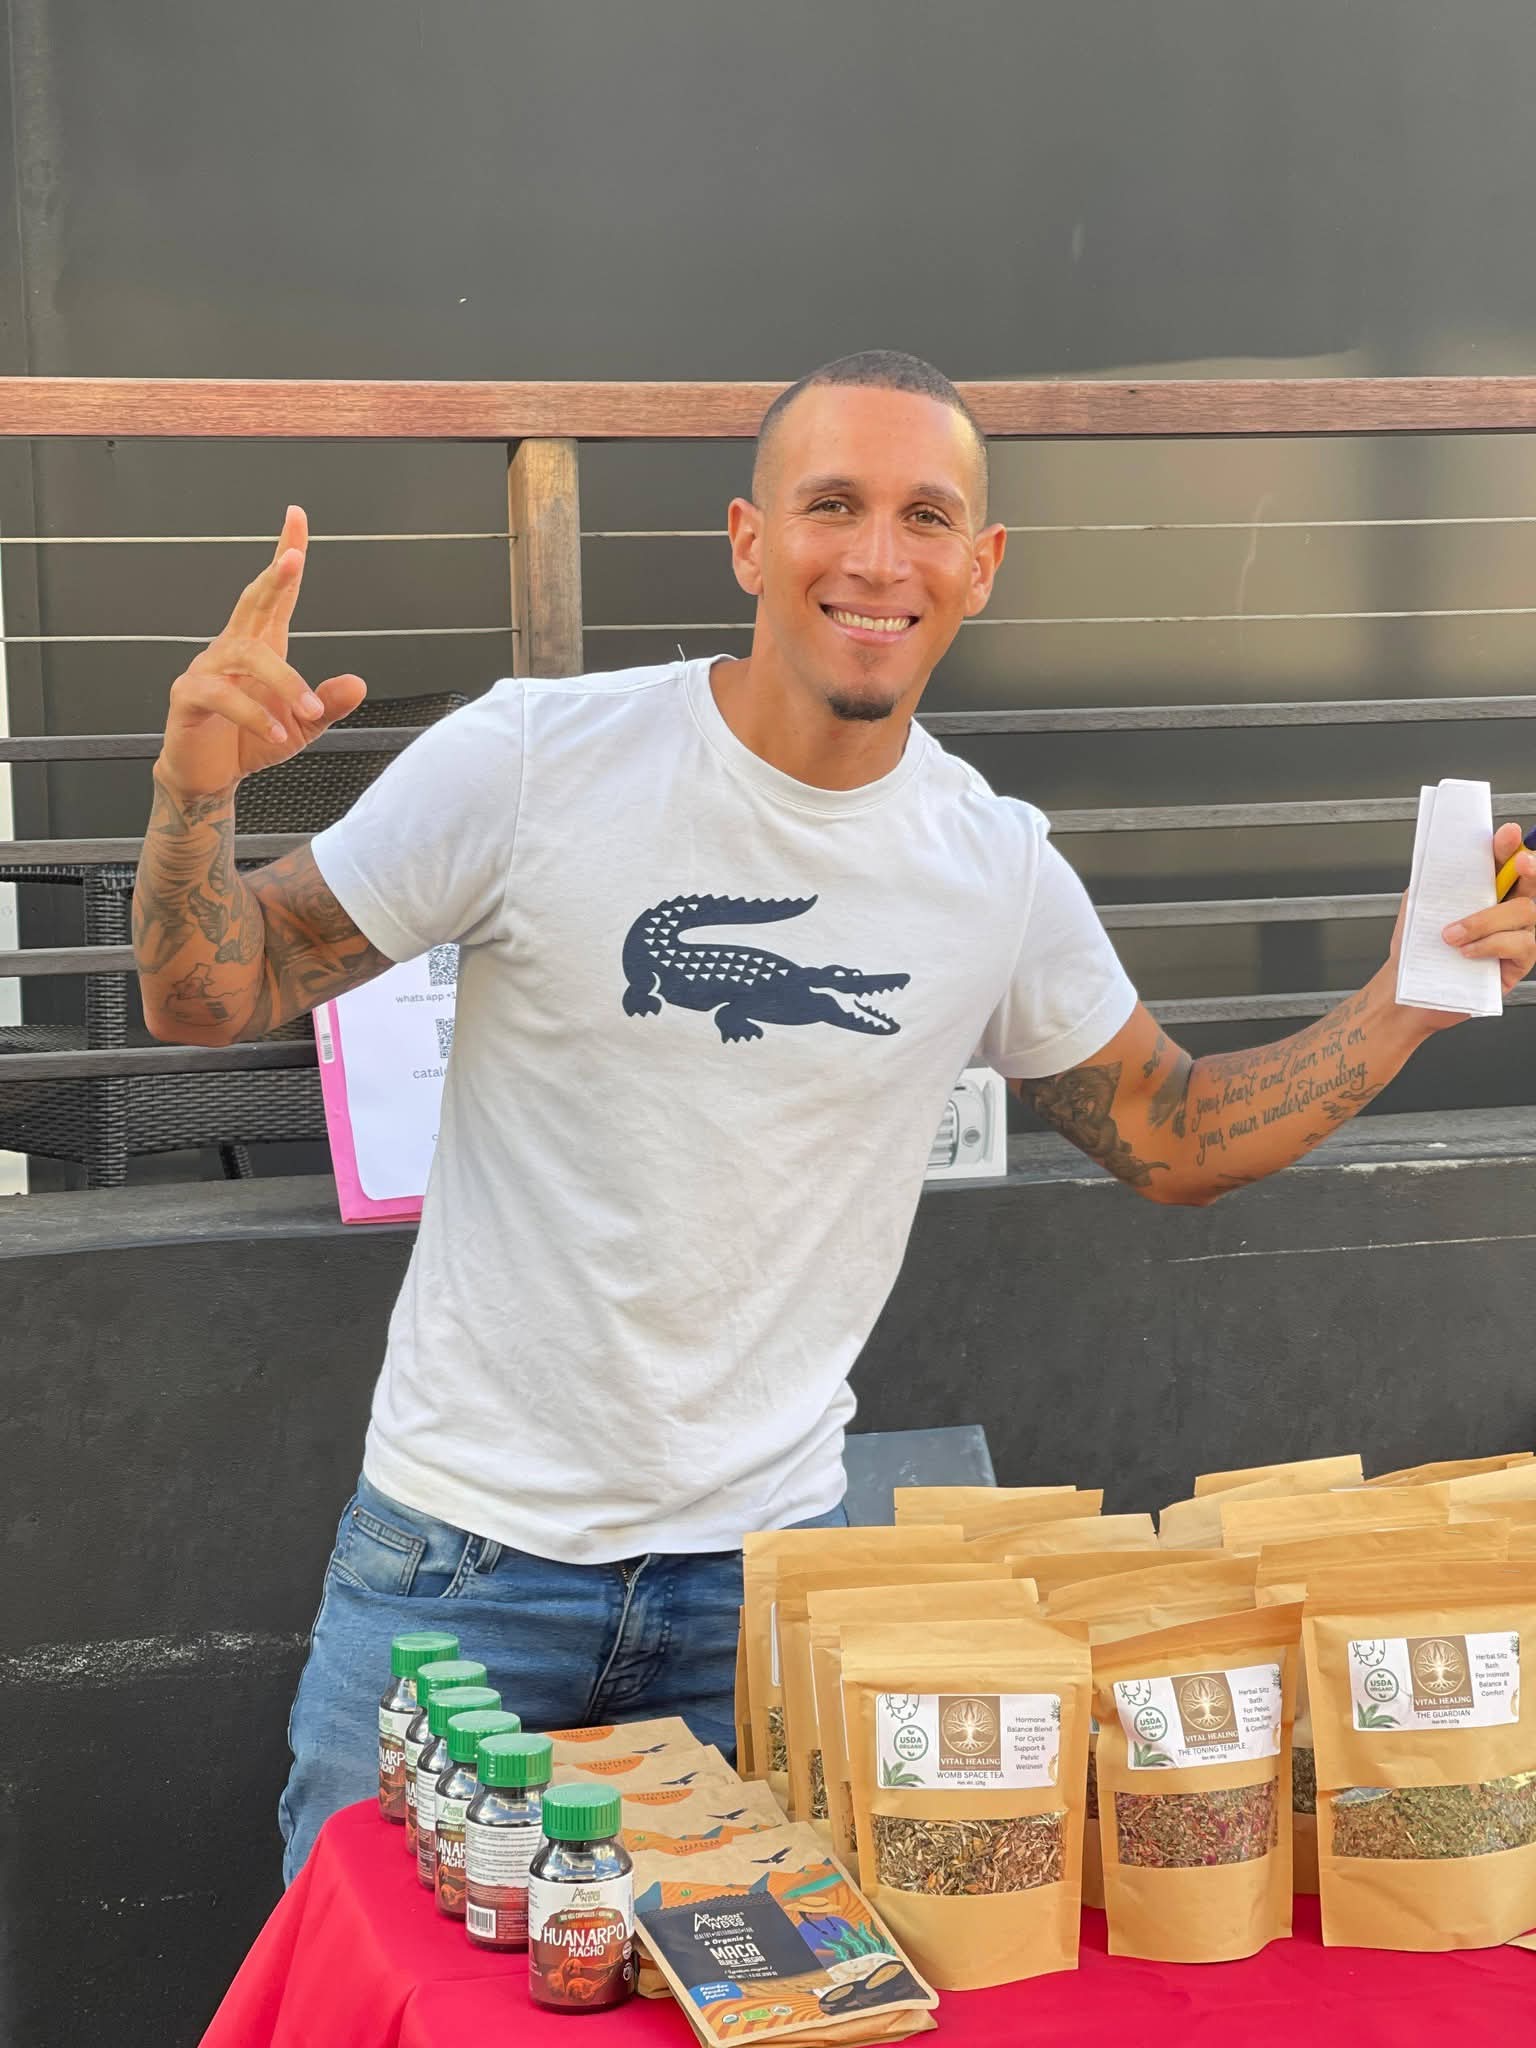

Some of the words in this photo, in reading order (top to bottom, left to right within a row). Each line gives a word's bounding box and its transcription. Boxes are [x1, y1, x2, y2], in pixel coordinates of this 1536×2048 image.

[395, 995, 425, 1003] whats
[426, 993, 444, 1003] app
[1415, 1698, 1438, 1706] VITAL
[1439, 1695, 1472, 1705] HEALING
[1432, 1710, 1471, 1718] GUARDIAN
[1140, 1718, 1161, 1726] USDA
[900, 1736, 922, 1744] USDA
[1185, 1733, 1207, 1743] VITAL
[1208, 1730, 1239, 1741] HEALING
[1193, 1745, 1219, 1754] TONING
[965, 1758, 1001, 1766] HEALING
[937, 1771, 962, 1779] WOMB
[963, 1771, 989, 1779] SPACE
[990, 1771, 1004, 1779] TEA
[543, 1922, 624, 1947] HUANARPO
[568, 1945, 605, 1957] MACHO
[709, 1943, 761, 1960] MACA
